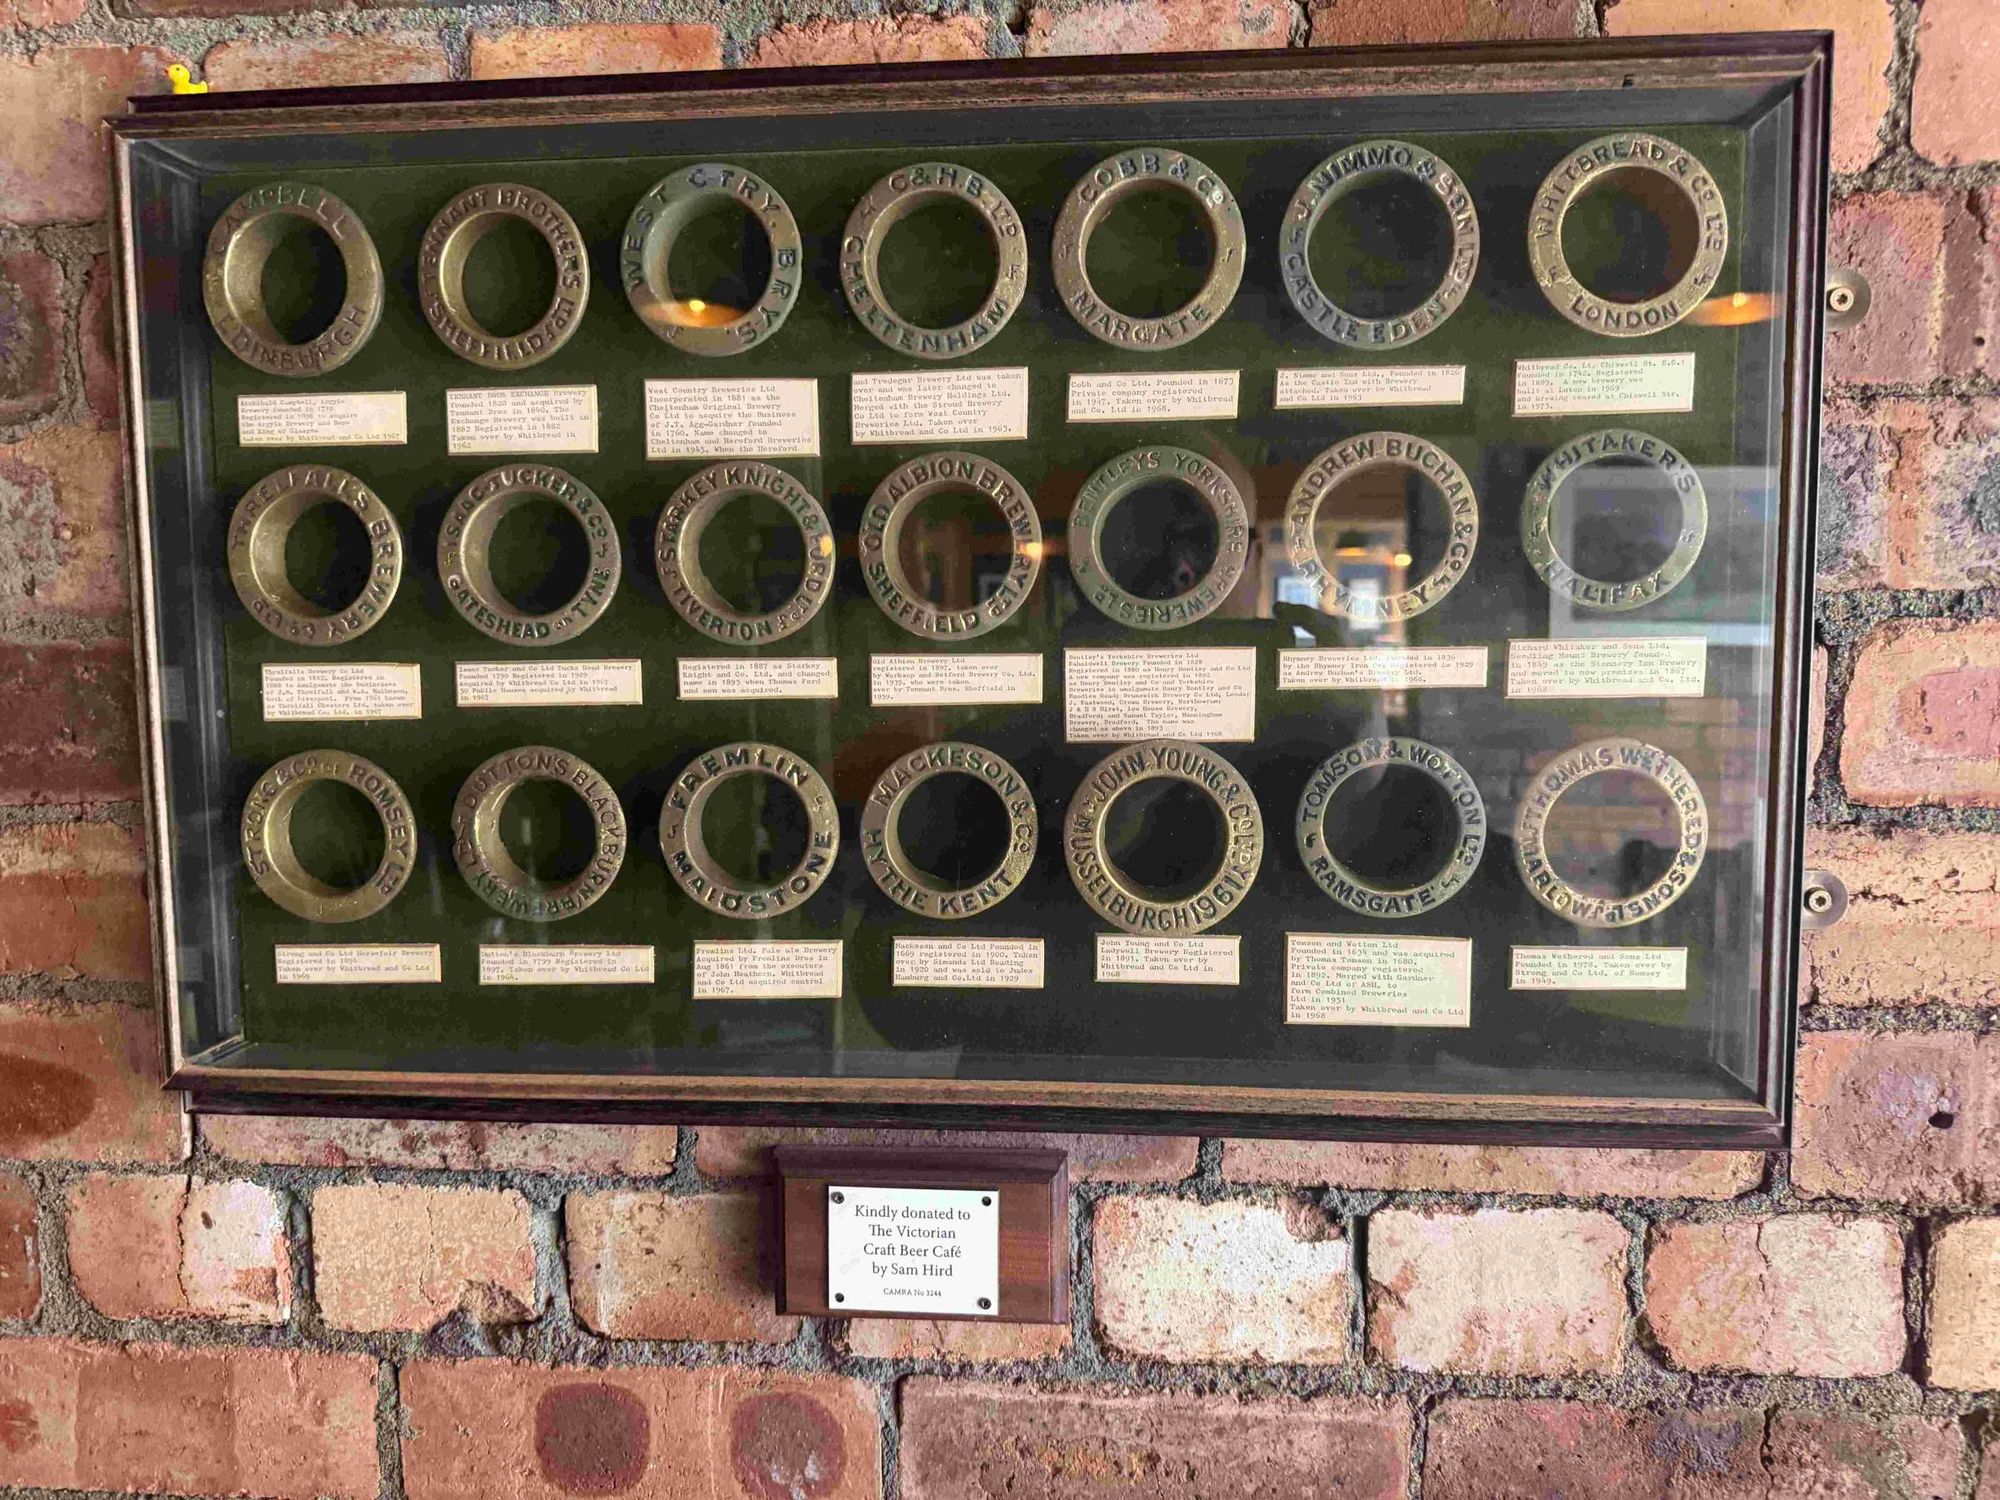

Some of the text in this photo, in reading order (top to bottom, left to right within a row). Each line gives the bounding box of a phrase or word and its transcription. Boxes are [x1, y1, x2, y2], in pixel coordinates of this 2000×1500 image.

[1078, 154, 1158, 205] COBB
[1308, 145, 1412, 196] NIMMO
[1536, 140, 1664, 240] WHITBREAD
[423, 190, 489, 282] TENNANT
[623, 184, 666, 293] WEST
[1071, 290, 1210, 343] MARGATE
[1287, 254, 1445, 344] CASTLE EDEN
[1571, 296, 1678, 328] LONDON
[217, 306, 367, 370] EDINBURGH
[429, 302, 543, 361] SHEFFIELD
[486, 469, 578, 500] TUCKER
[888, 458, 975, 502] ALBION
[1173, 453, 1243, 552] YORKSHIRE
[1293, 440, 1374, 525] ANDREW
[1386, 439, 1471, 515] BUCHAN
[659, 472, 717, 561] STARKEY
[724, 467, 811, 514] KNIGHT
[448, 575, 549, 638] GATESHEAD
[571, 568, 610, 617] TYNE
[868, 563, 978, 633] SHEFFIELD
[1544, 559, 1672, 604] HALIFAX
[674, 582, 772, 640] TIVERTON
[797, 670, 830, 678] changed
[872, 747, 1020, 806] MACKESON
[1093, 751, 1145, 802] JOHN
[1150, 748, 1227, 788] YOUNG
[1302, 738, 1382, 822] TOMSON
[1409, 744, 1480, 826] WOTTON
[245, 781, 276, 875] STRONG
[348, 763, 408, 859] ROMSEY
[572, 768, 620, 901] BLACKBURN
[672, 832, 832, 913] MAIDSTONE
[864, 828, 1012, 914] HYTHE KENT
[1070, 814, 1188, 931] MUSSELBURGH
[1311, 856, 1436, 913] RAMSGATE
[1627, 869, 1686, 917] SONS
[1346, 1005, 1356, 1013] by
[1361, 1006, 1407, 1014] Whitbread
[855, 1204, 970, 1220] Kindly donated to
[869, 1224, 956, 1239] The Victorian
[863, 1243, 962, 1258] Craft Beer Café
[872, 1262, 953, 1278] by Sam Hird
[883, 1288, 912, 1296] CAMRA
